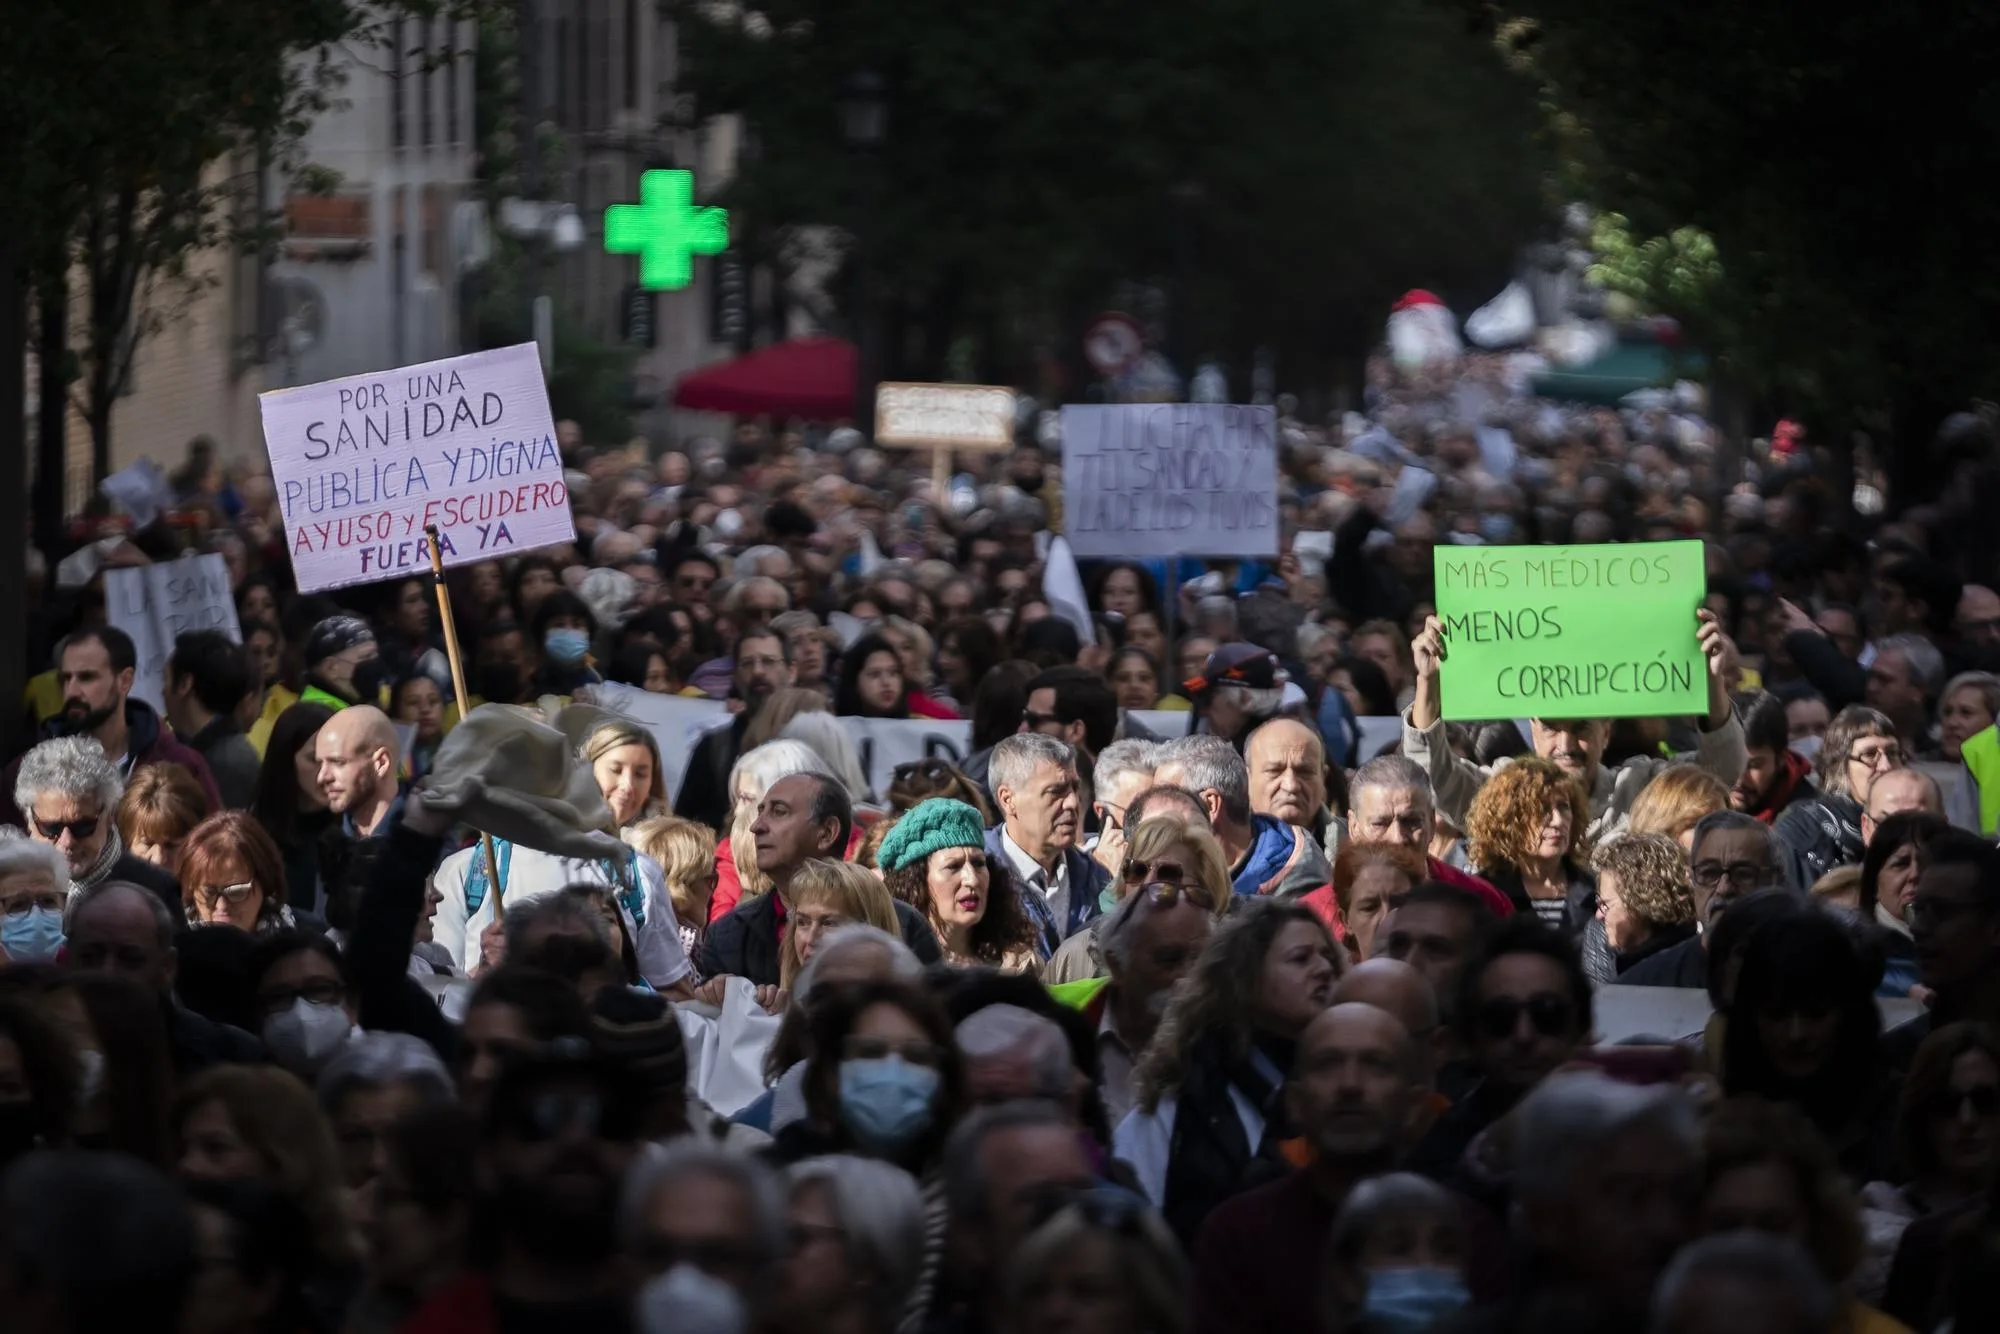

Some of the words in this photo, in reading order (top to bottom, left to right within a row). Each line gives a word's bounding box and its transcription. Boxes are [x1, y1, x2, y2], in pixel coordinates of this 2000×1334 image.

[339, 383, 389, 414] POR
[408, 369, 466, 400] UNA
[304, 392, 504, 460] SANIDAD
[285, 456, 429, 517] PUBLICA
[294, 511, 392, 557] AYUSO
[423, 480, 568, 530] ESCUDERO
[360, 533, 457, 574] FUERA
[475, 521, 514, 549] YA
[1445, 551, 1510, 588] MÁS
[1525, 549, 1671, 588] MÉDICOS
[1446, 605, 1562, 643] MENOS
[1497, 650, 1691, 698] CORRUPCIÓN
